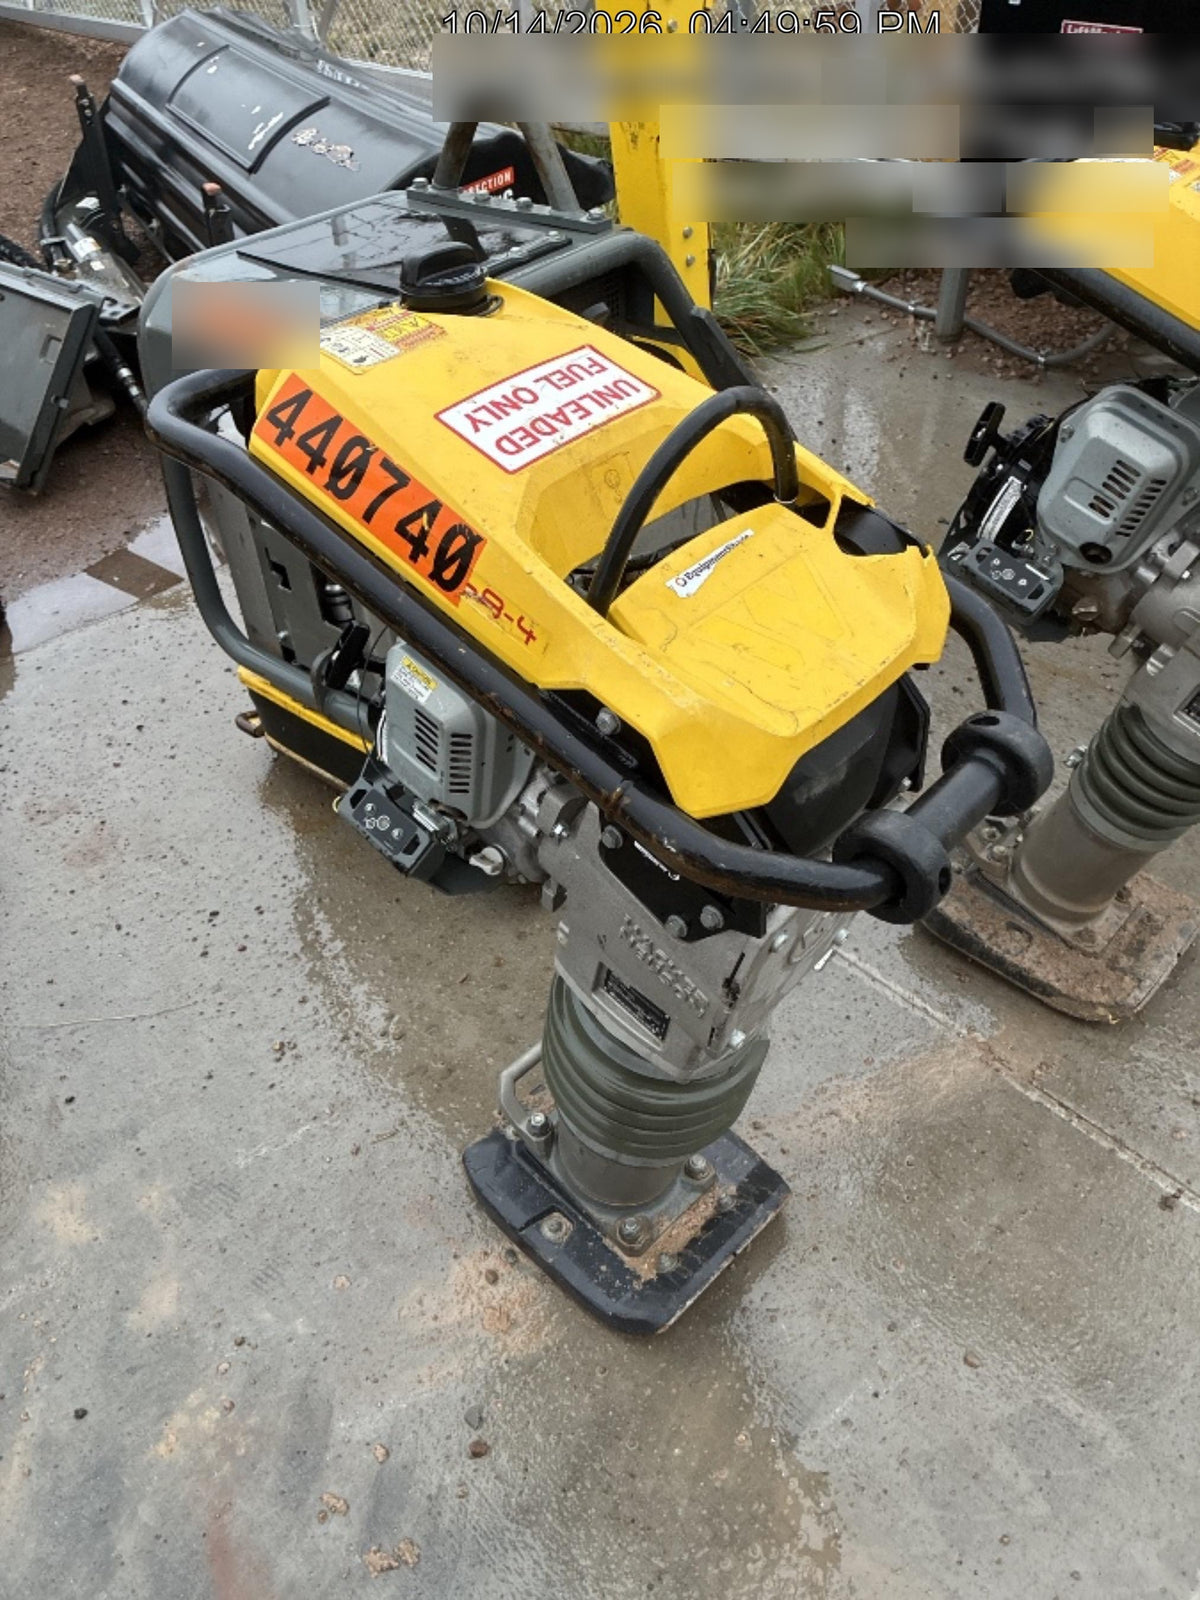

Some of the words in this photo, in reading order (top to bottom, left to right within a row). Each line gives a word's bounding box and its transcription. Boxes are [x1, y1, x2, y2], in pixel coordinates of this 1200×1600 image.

[533, 357, 608, 390] FUEL
[464, 387, 539, 433] ONLY
[495, 379, 641, 455] UNLEADED
[266, 389, 484, 592] 440740
